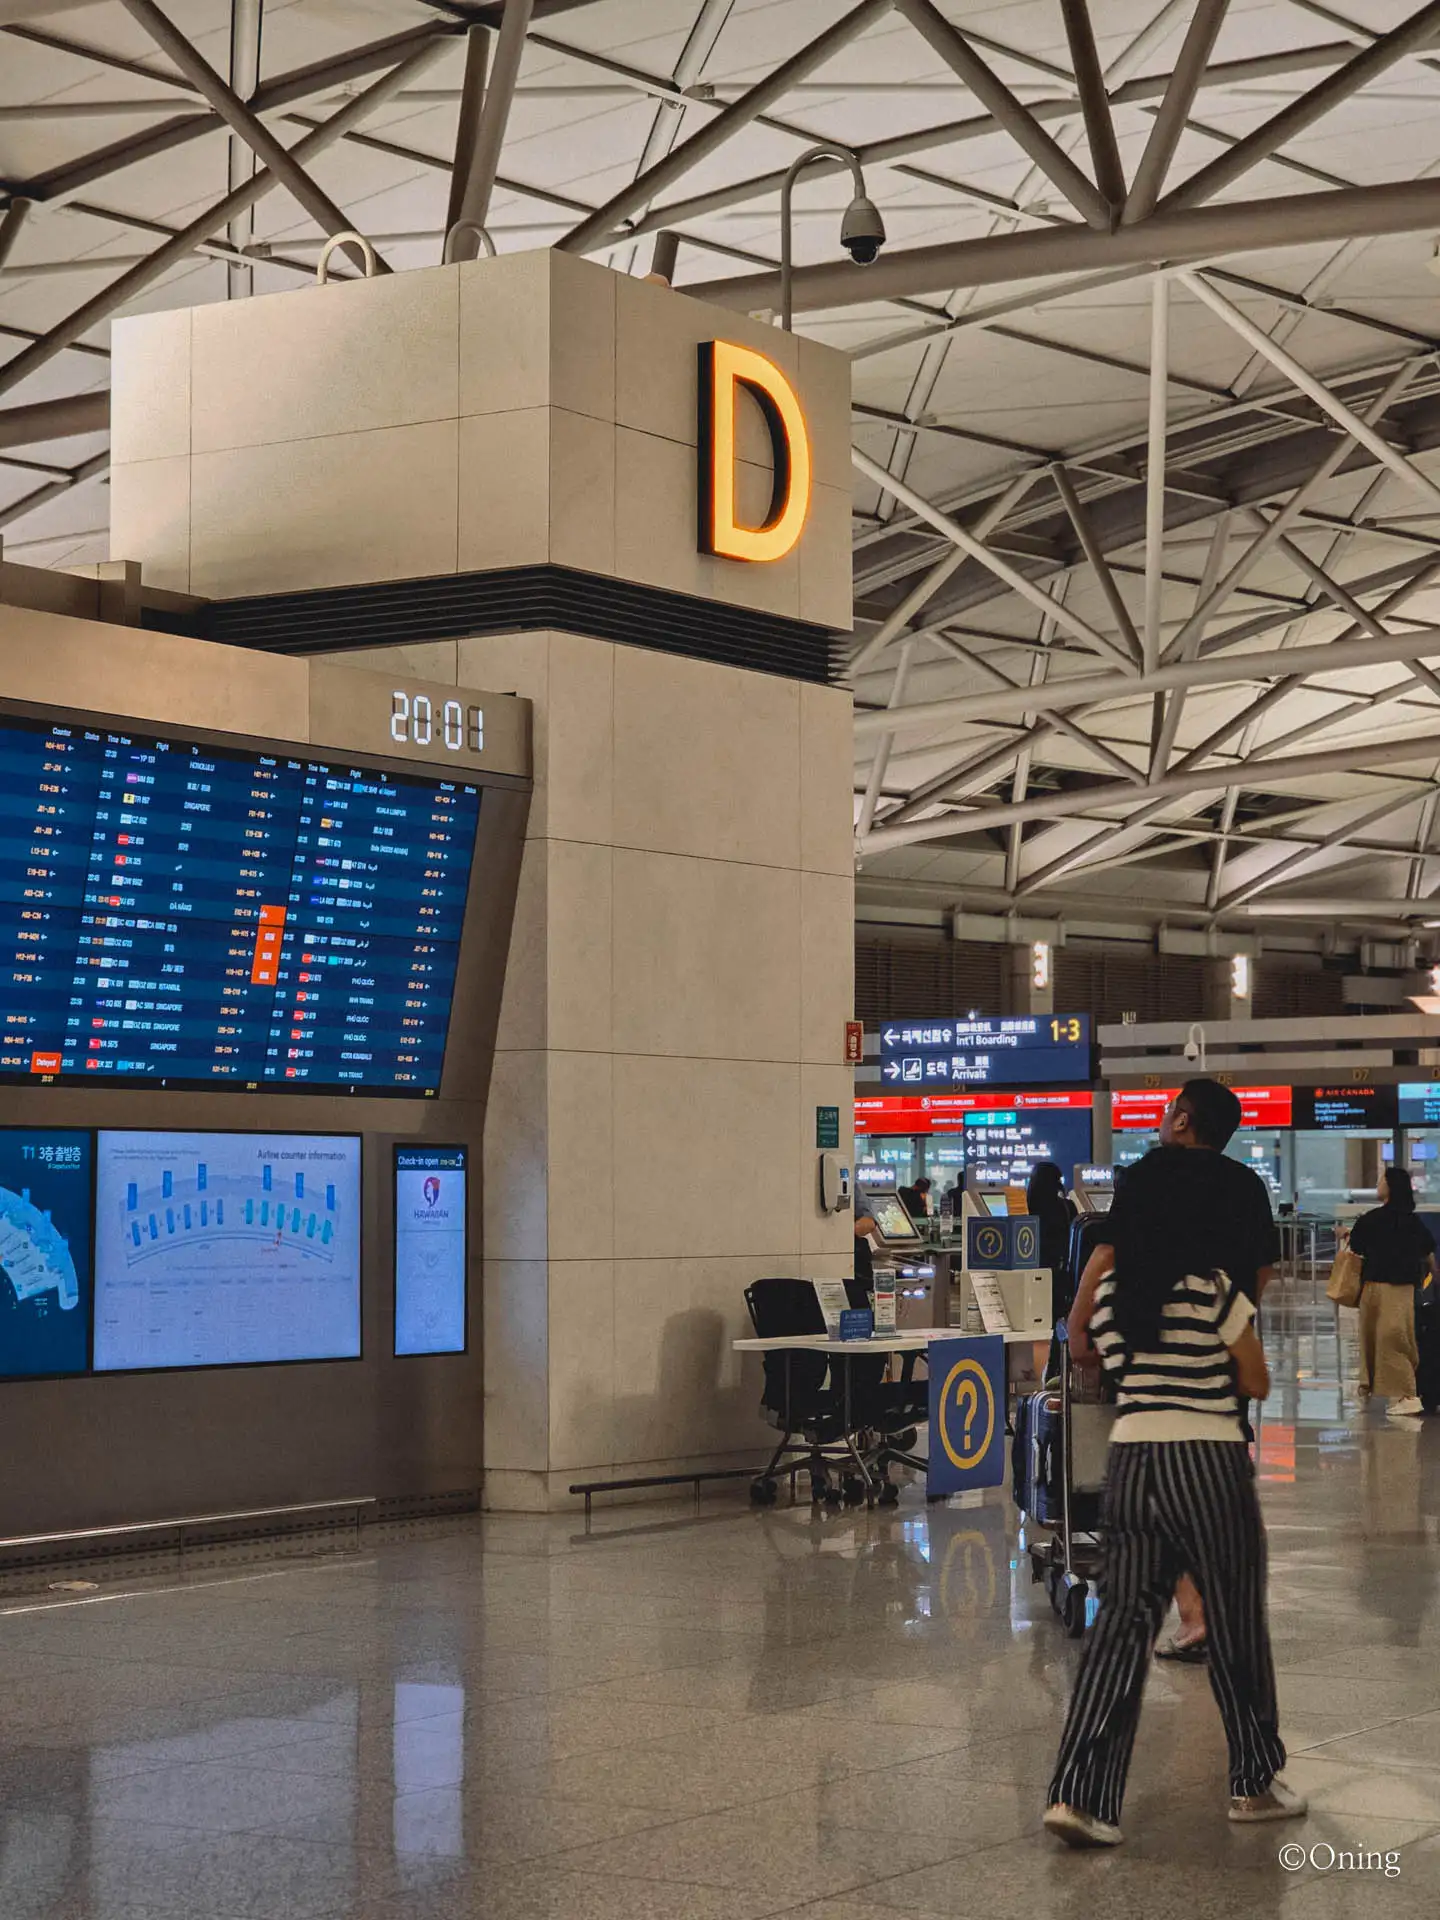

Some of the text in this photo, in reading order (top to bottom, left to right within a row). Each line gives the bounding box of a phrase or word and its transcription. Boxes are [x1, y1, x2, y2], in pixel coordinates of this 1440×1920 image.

[704, 339, 812, 562] D
[391, 691, 484, 752] 20:01
[1050, 1018, 1081, 1042] 1-3
[956, 1033, 1017, 1047] Int'l Boarding
[926, 1060, 947, 1076] 도착
[951, 1068, 987, 1080] Arrivals
[1325, 1088, 1374, 1097] AIR CANADA
[21, 1145, 35, 1160] T1
[257, 1149, 346, 1161] Airline counter information
[398, 1155, 424, 1166] Check-in
